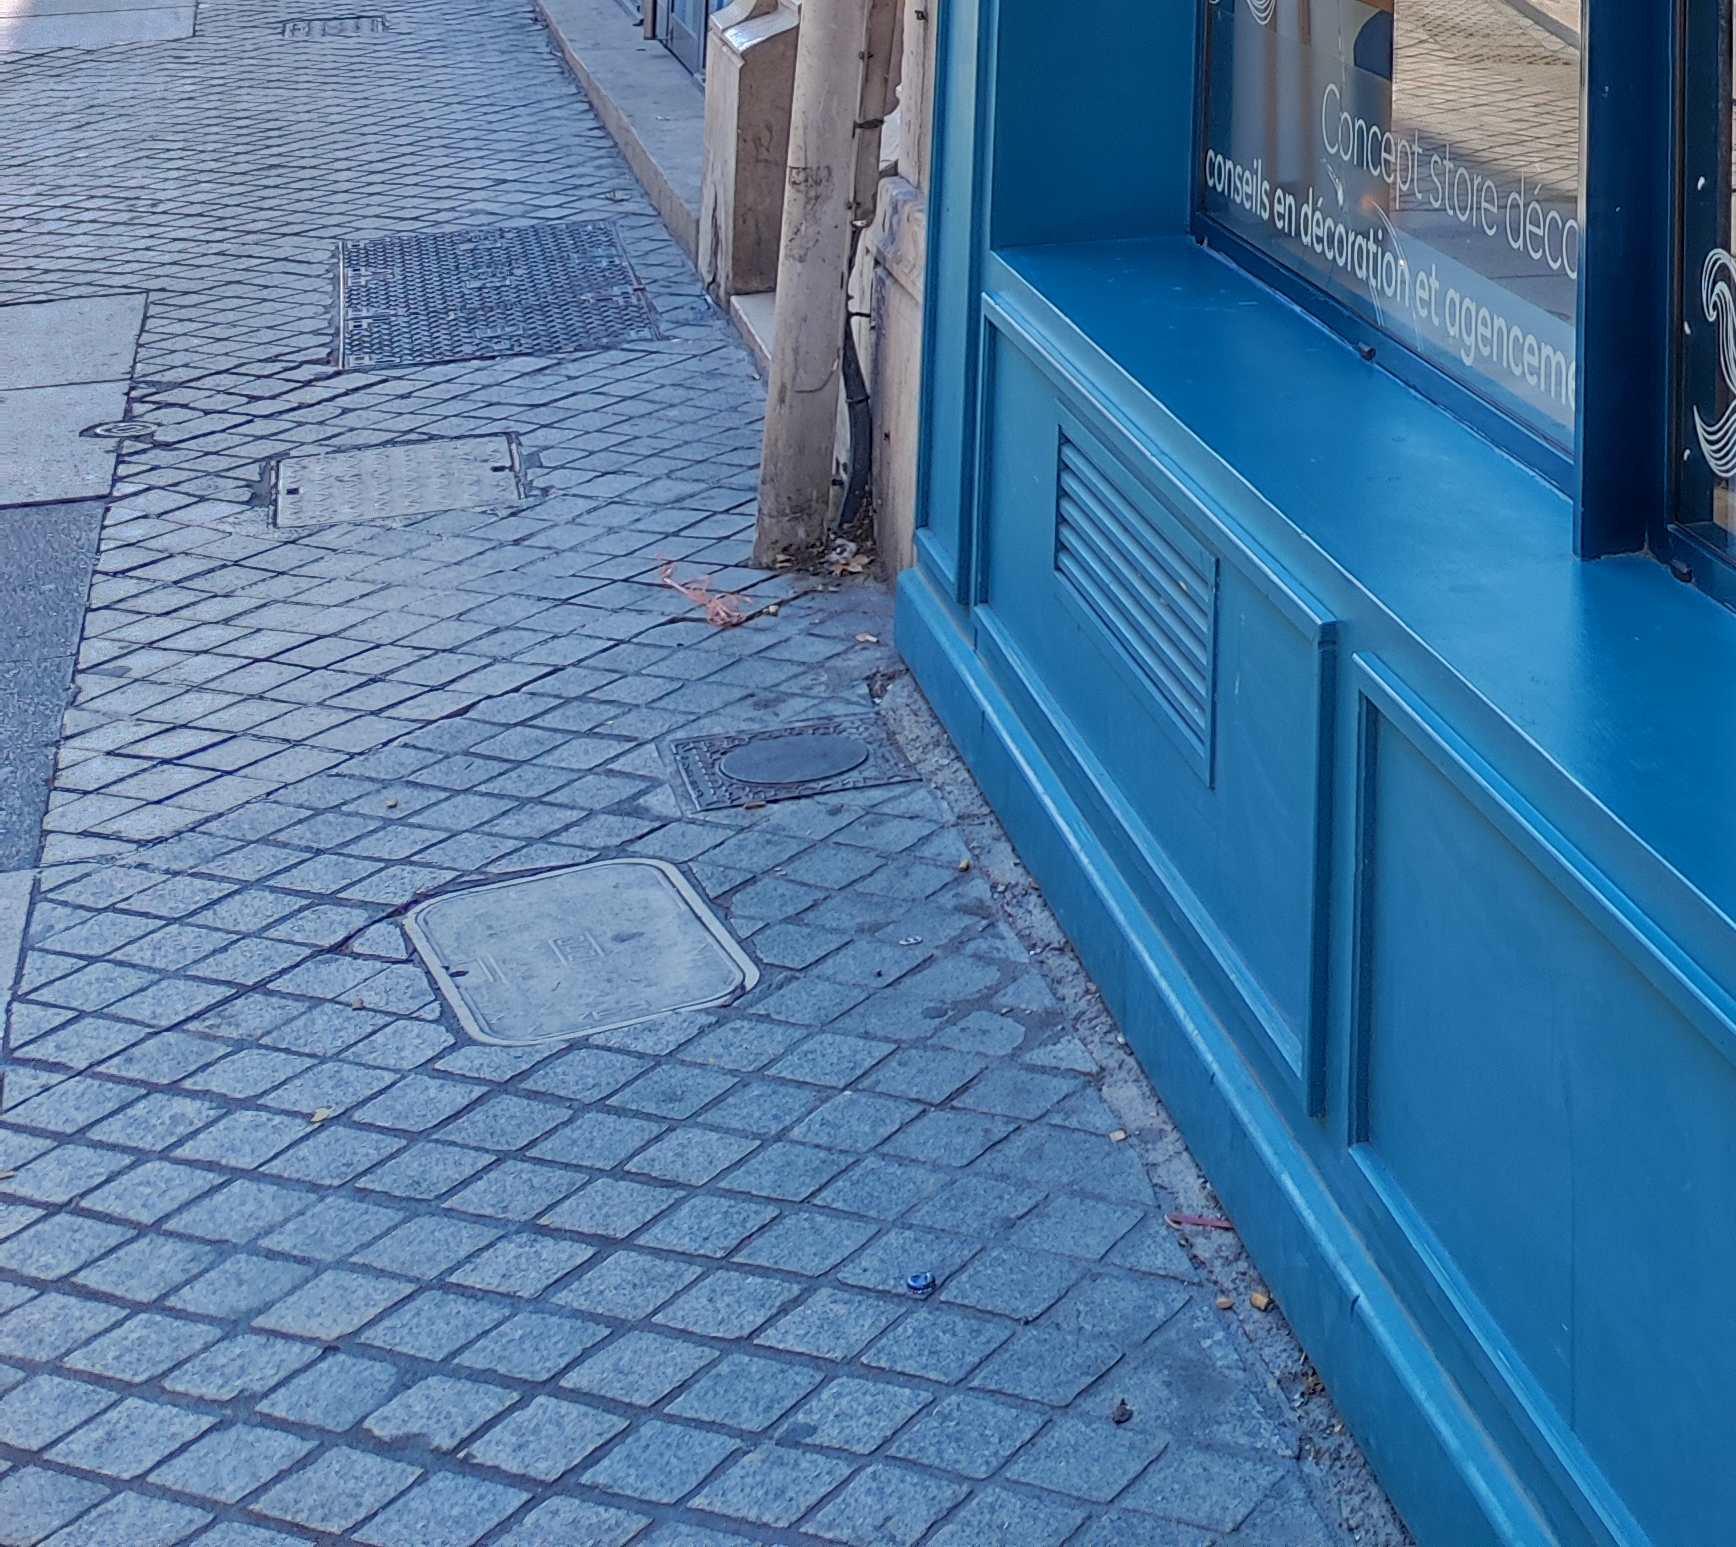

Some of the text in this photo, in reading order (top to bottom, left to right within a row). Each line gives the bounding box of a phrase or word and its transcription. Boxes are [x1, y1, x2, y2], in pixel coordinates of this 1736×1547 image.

[1205, 147, 1271, 222] conseils
[1273, 187, 1296, 238] en
[1299, 186, 1411, 309] décoration
[1415, 263, 1440, 327] et
[1321, 82, 1578, 280] Concept store déco
